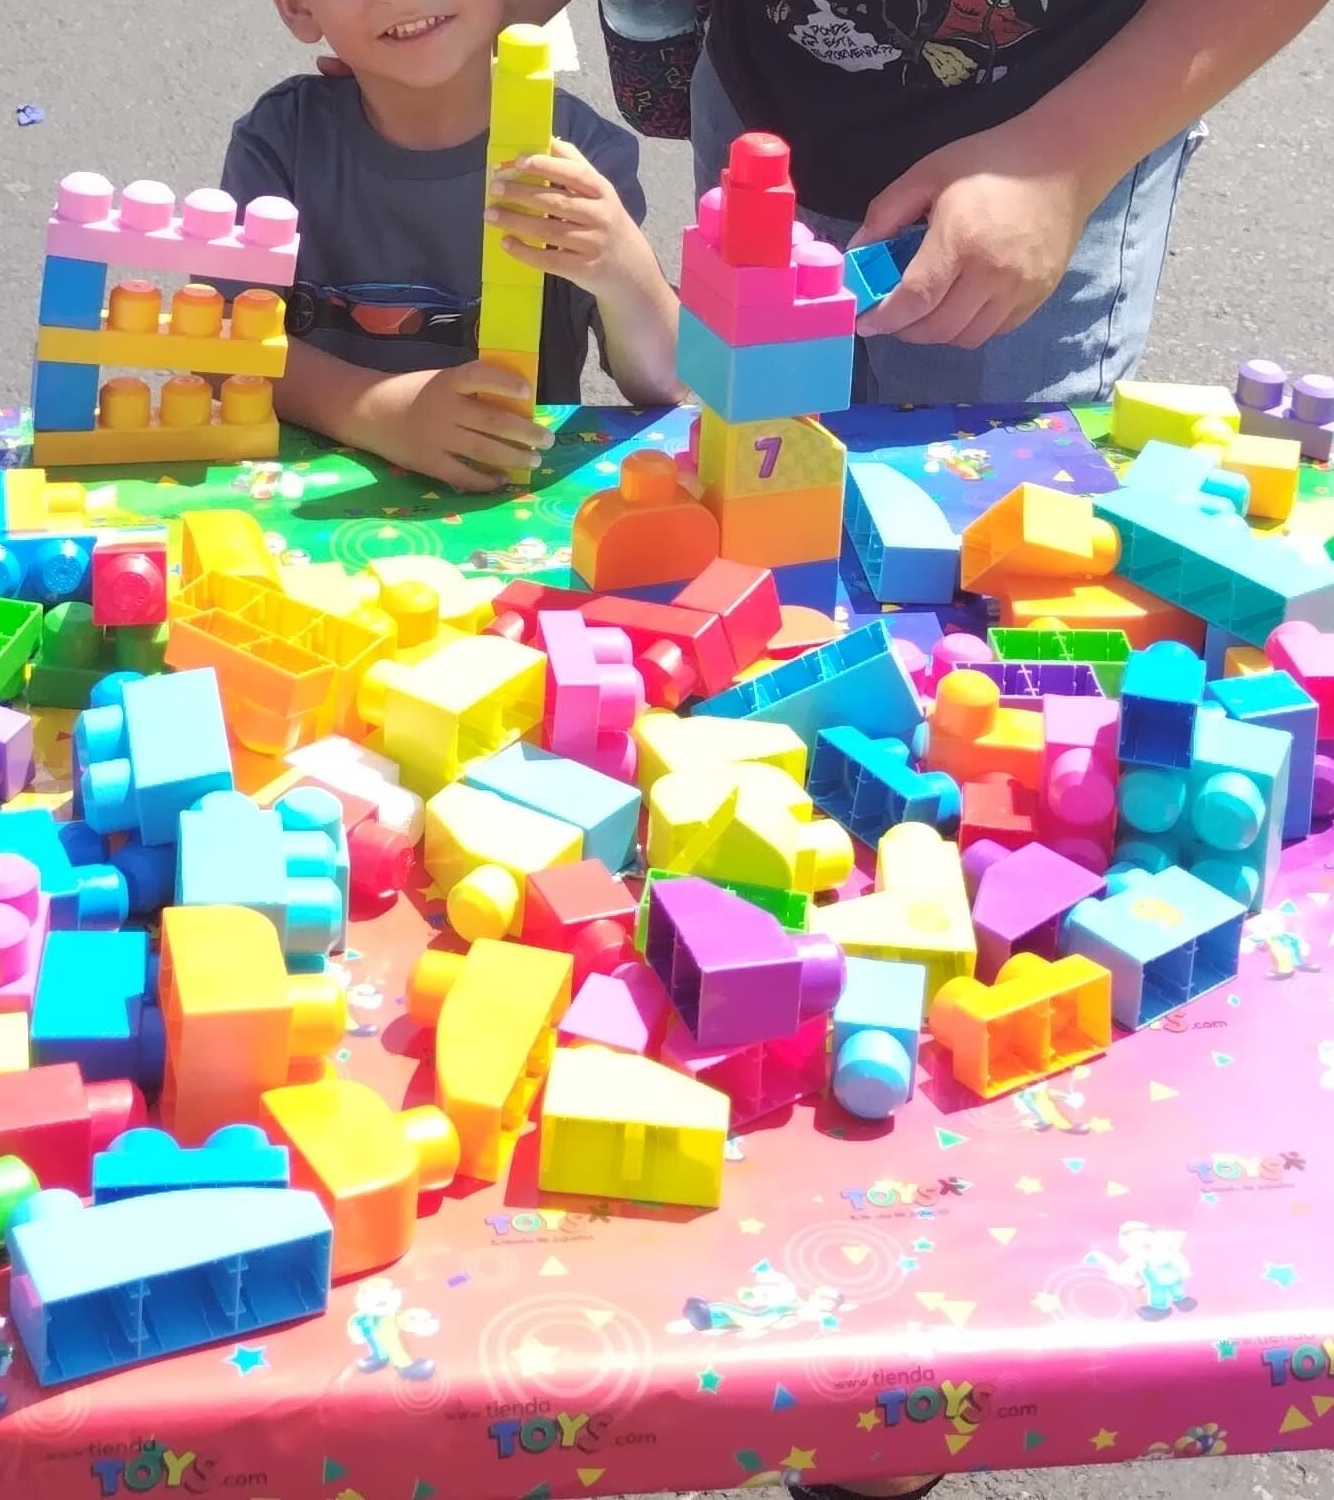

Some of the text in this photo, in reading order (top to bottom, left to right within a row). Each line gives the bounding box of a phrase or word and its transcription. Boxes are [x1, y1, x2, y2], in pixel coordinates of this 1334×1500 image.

[753, 435, 783, 479] 7
[485, 1207, 584, 1237] TOYS
[875, 1379, 994, 1428] TOYS
[487, 1410, 614, 1460] TOYS
[90, 1449, 217, 1497] TOYS
